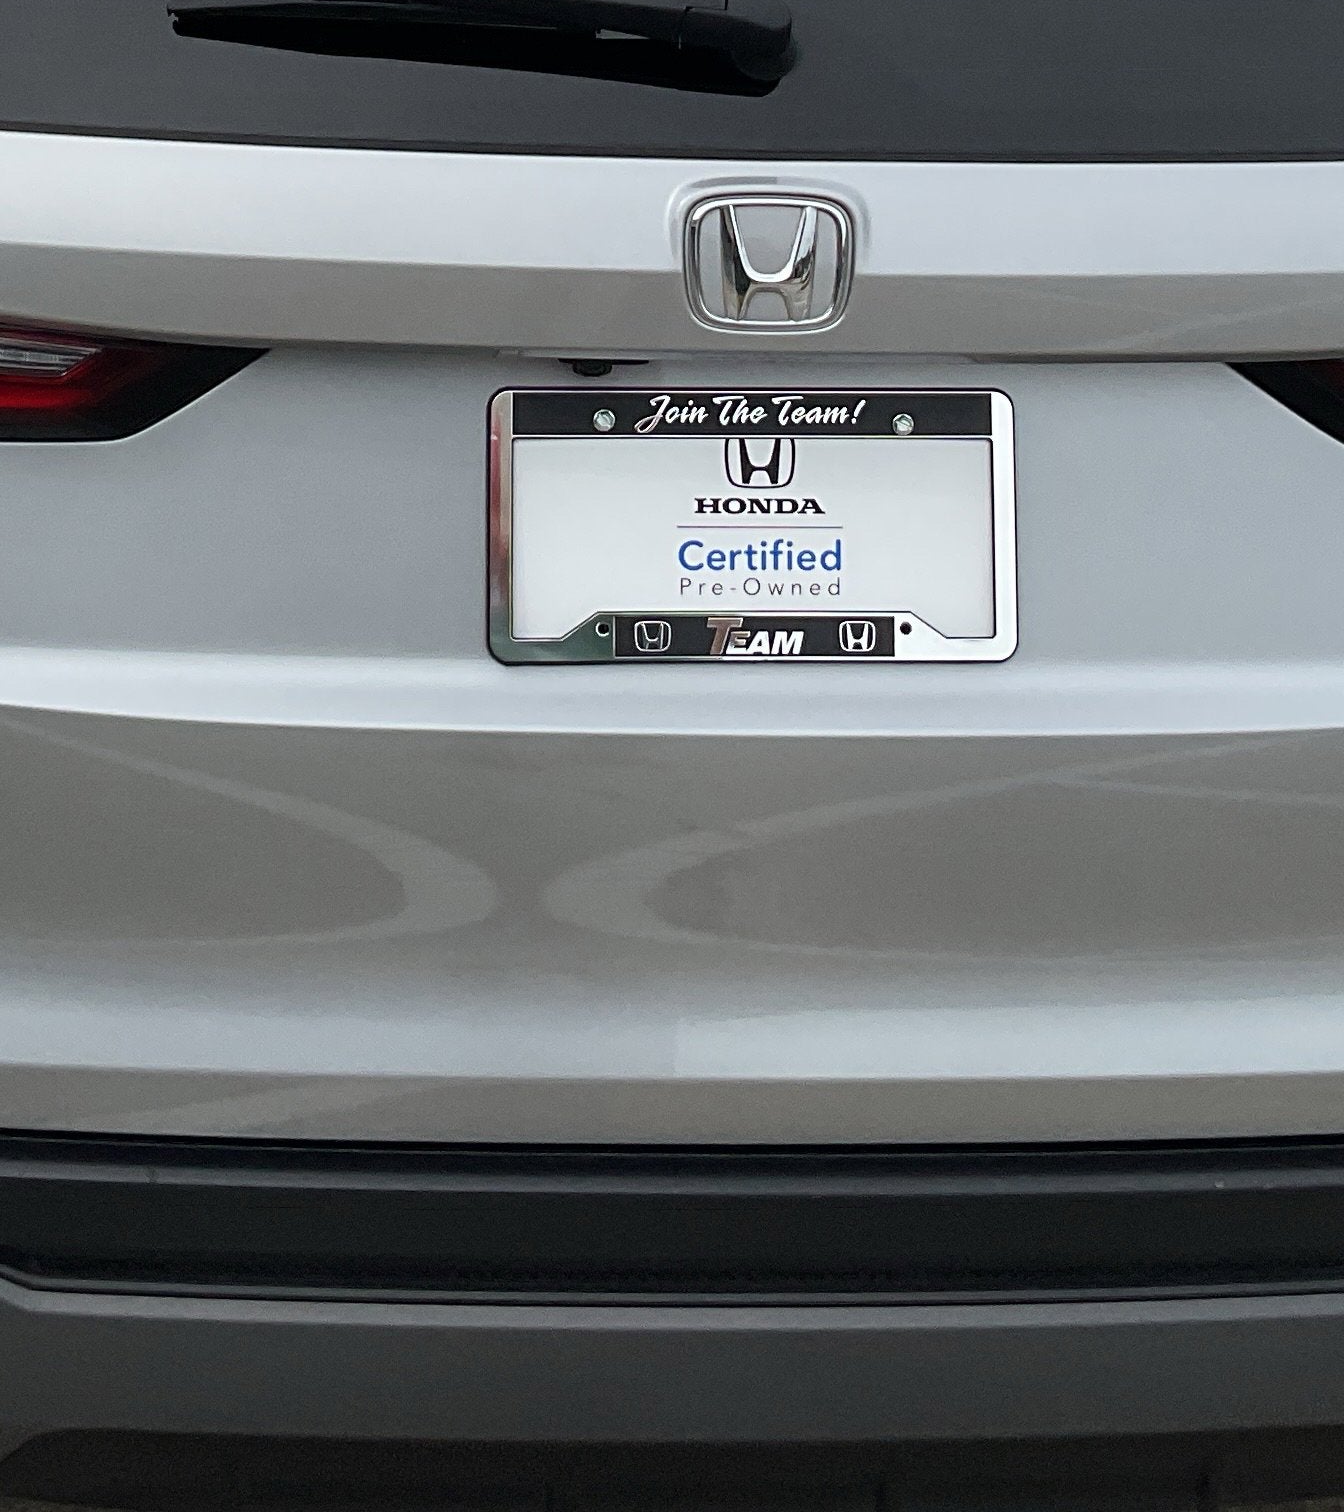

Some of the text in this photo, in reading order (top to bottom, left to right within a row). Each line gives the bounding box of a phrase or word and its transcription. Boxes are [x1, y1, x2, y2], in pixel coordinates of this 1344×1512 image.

[633, 395, 867, 433] Join The Team!
[693, 497, 826, 516] HONDA
[677, 539, 843, 572] Certified
[679, 577, 842, 597] Pre-Owned
[706, 616, 805, 656] TEAM
